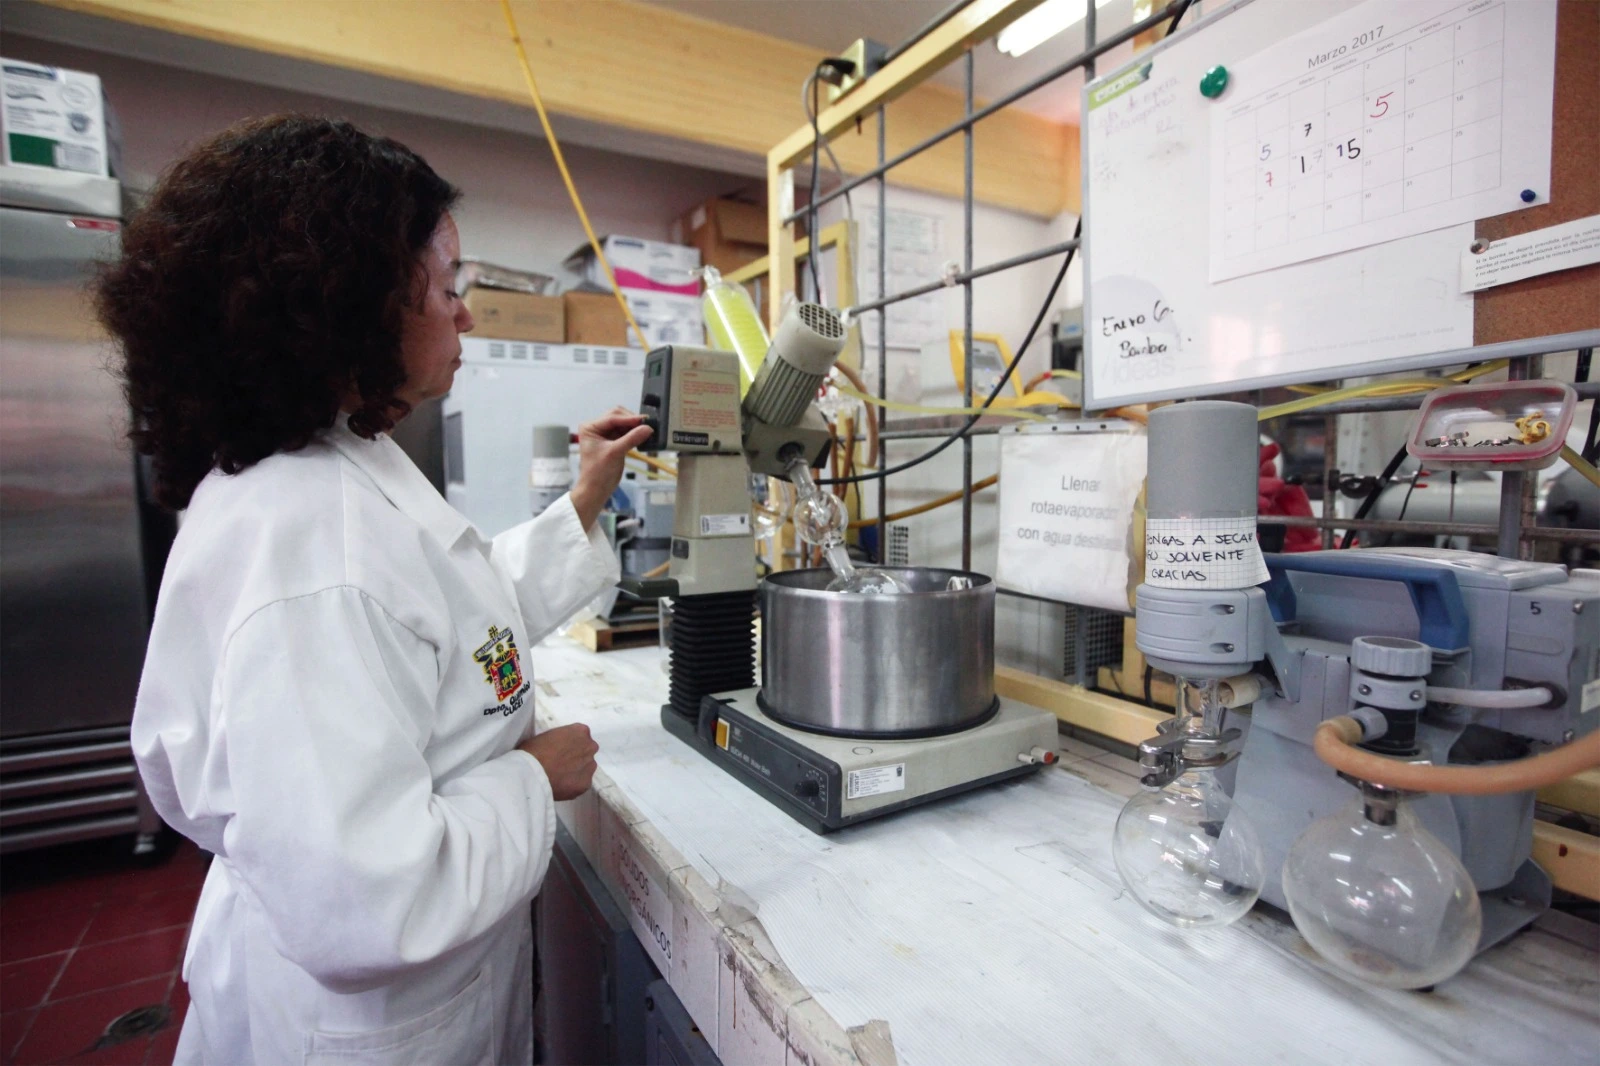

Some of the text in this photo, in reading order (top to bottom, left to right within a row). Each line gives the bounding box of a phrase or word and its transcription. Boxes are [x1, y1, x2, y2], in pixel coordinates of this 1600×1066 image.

[1307, 25, 1385, 69] Marzo 2017
[1369, 91, 1394, 118] 5
[1304, 123, 1312, 138] 7
[1259, 143, 1272, 162] 5
[1264, 171, 1273, 187] 7
[1060, 475, 1101, 492] Llenar
[1017, 527, 1040, 540] con
[1042, 530, 1072, 547] agua
[1192, 534, 1206, 546] A
[1166, 549, 1244, 563] SOLVENTE
[1151, 568, 1207, 581] GRACIAS
[1530, 601, 1542, 616] 5
